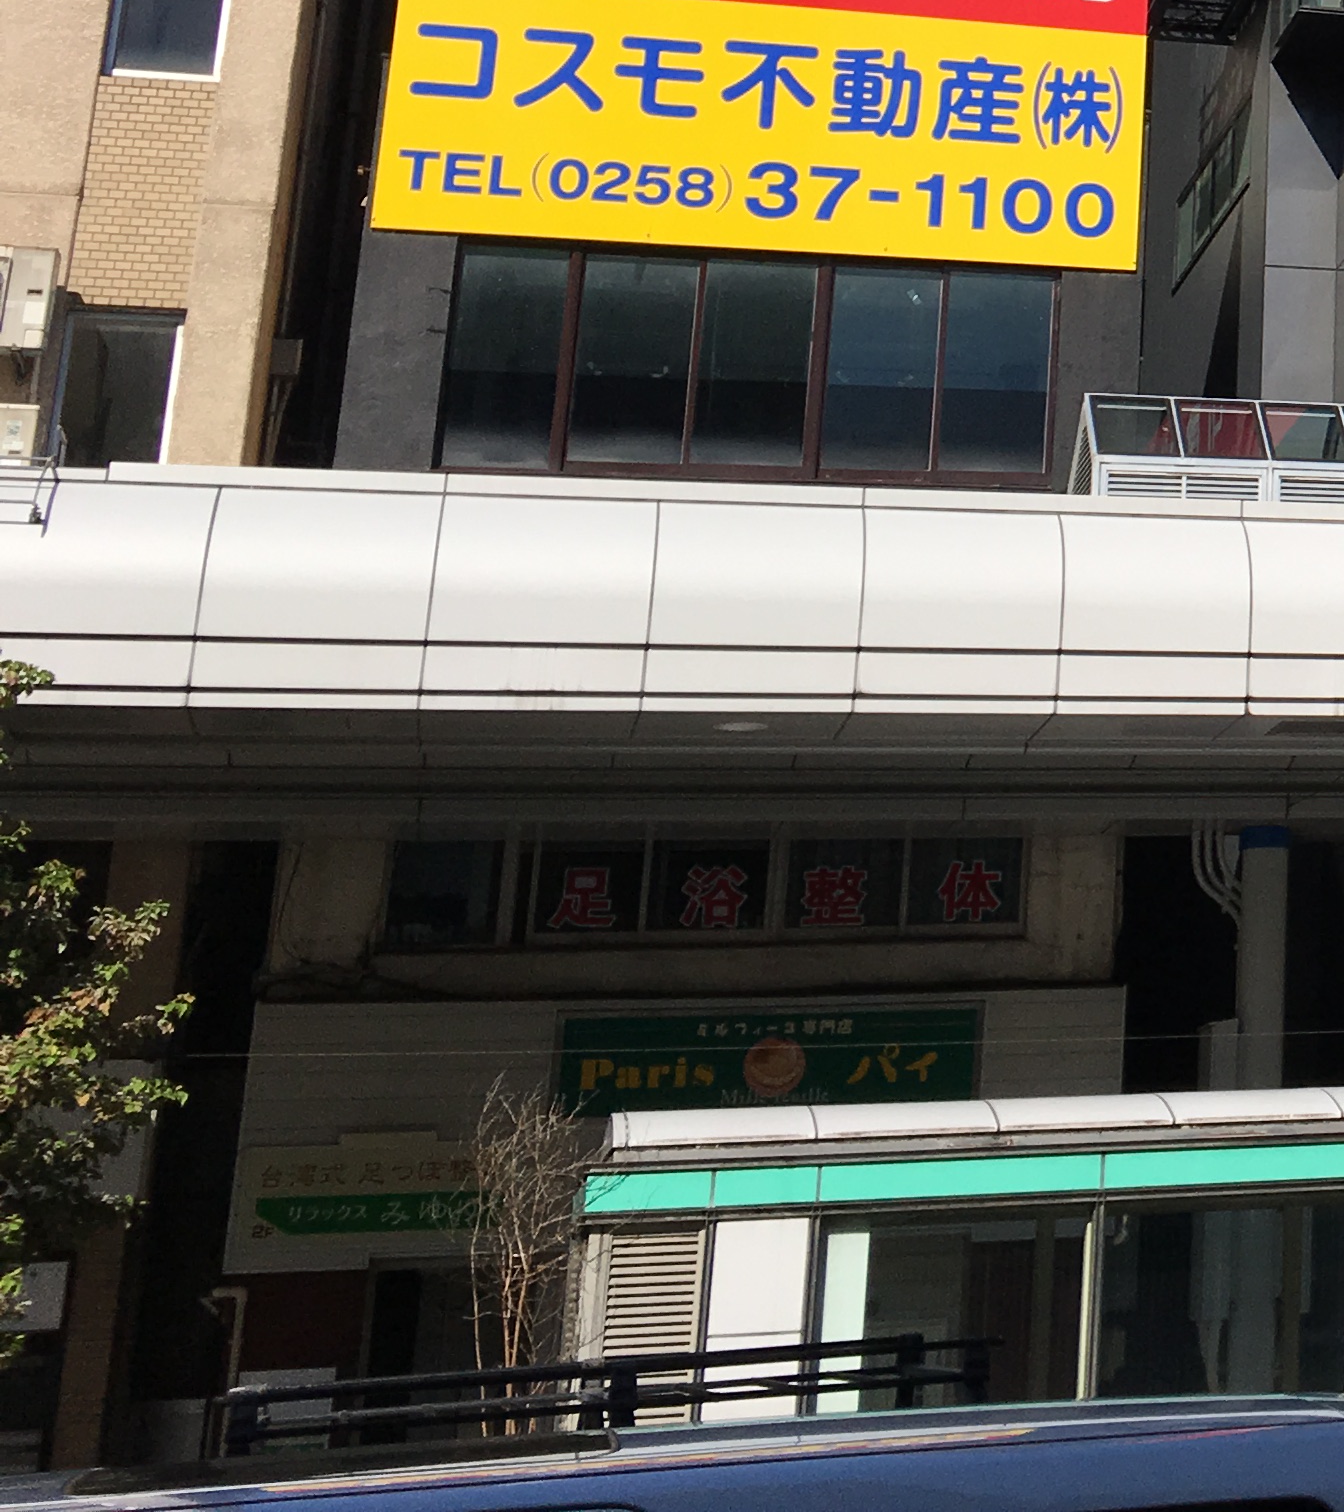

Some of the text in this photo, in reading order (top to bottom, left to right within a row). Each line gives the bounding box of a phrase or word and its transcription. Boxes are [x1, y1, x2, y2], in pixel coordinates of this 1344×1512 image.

[547, 860, 1002, 928] 足浴整体
[579, 1055, 716, 1090] Paris
[846, 1042, 938, 1085] パイ
[359, 1158, 502, 1185] 足つぼ整
